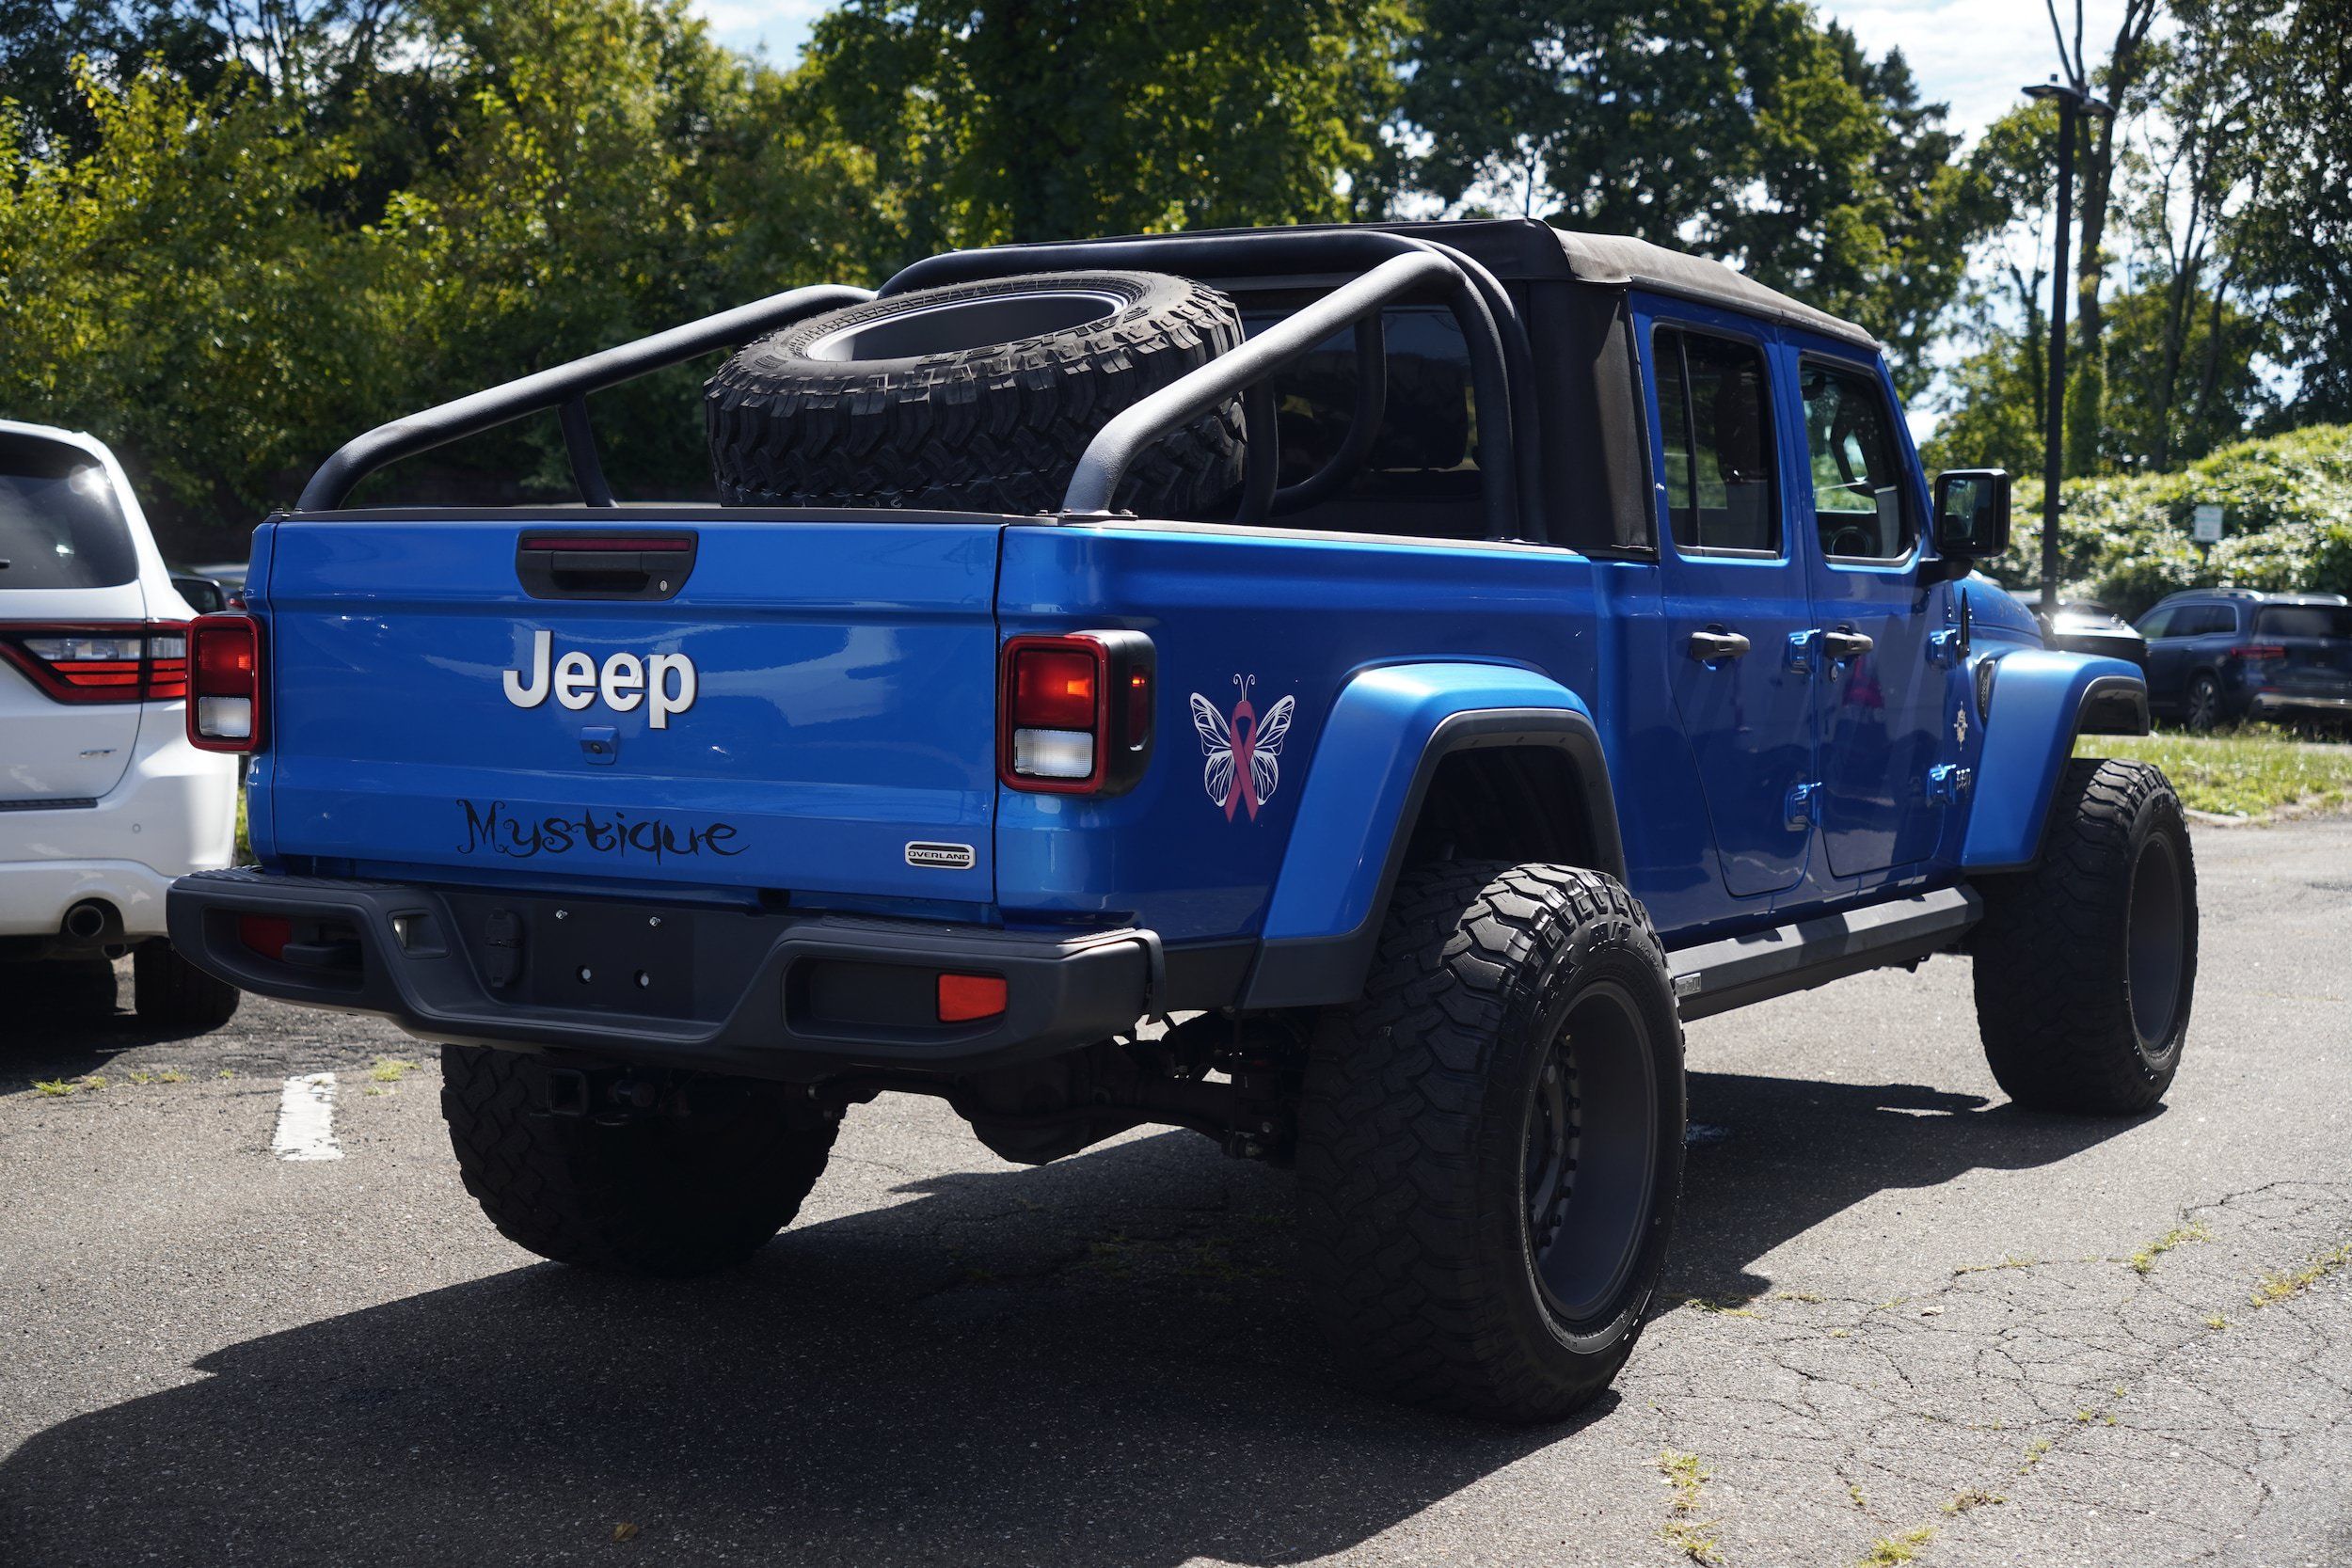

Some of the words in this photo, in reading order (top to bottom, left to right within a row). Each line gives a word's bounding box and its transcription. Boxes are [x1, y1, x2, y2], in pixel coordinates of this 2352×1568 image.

[502, 629, 698, 730] Jeep
[456, 800, 751, 865] Mystique
[907, 849, 971, 861] OVERLAND
